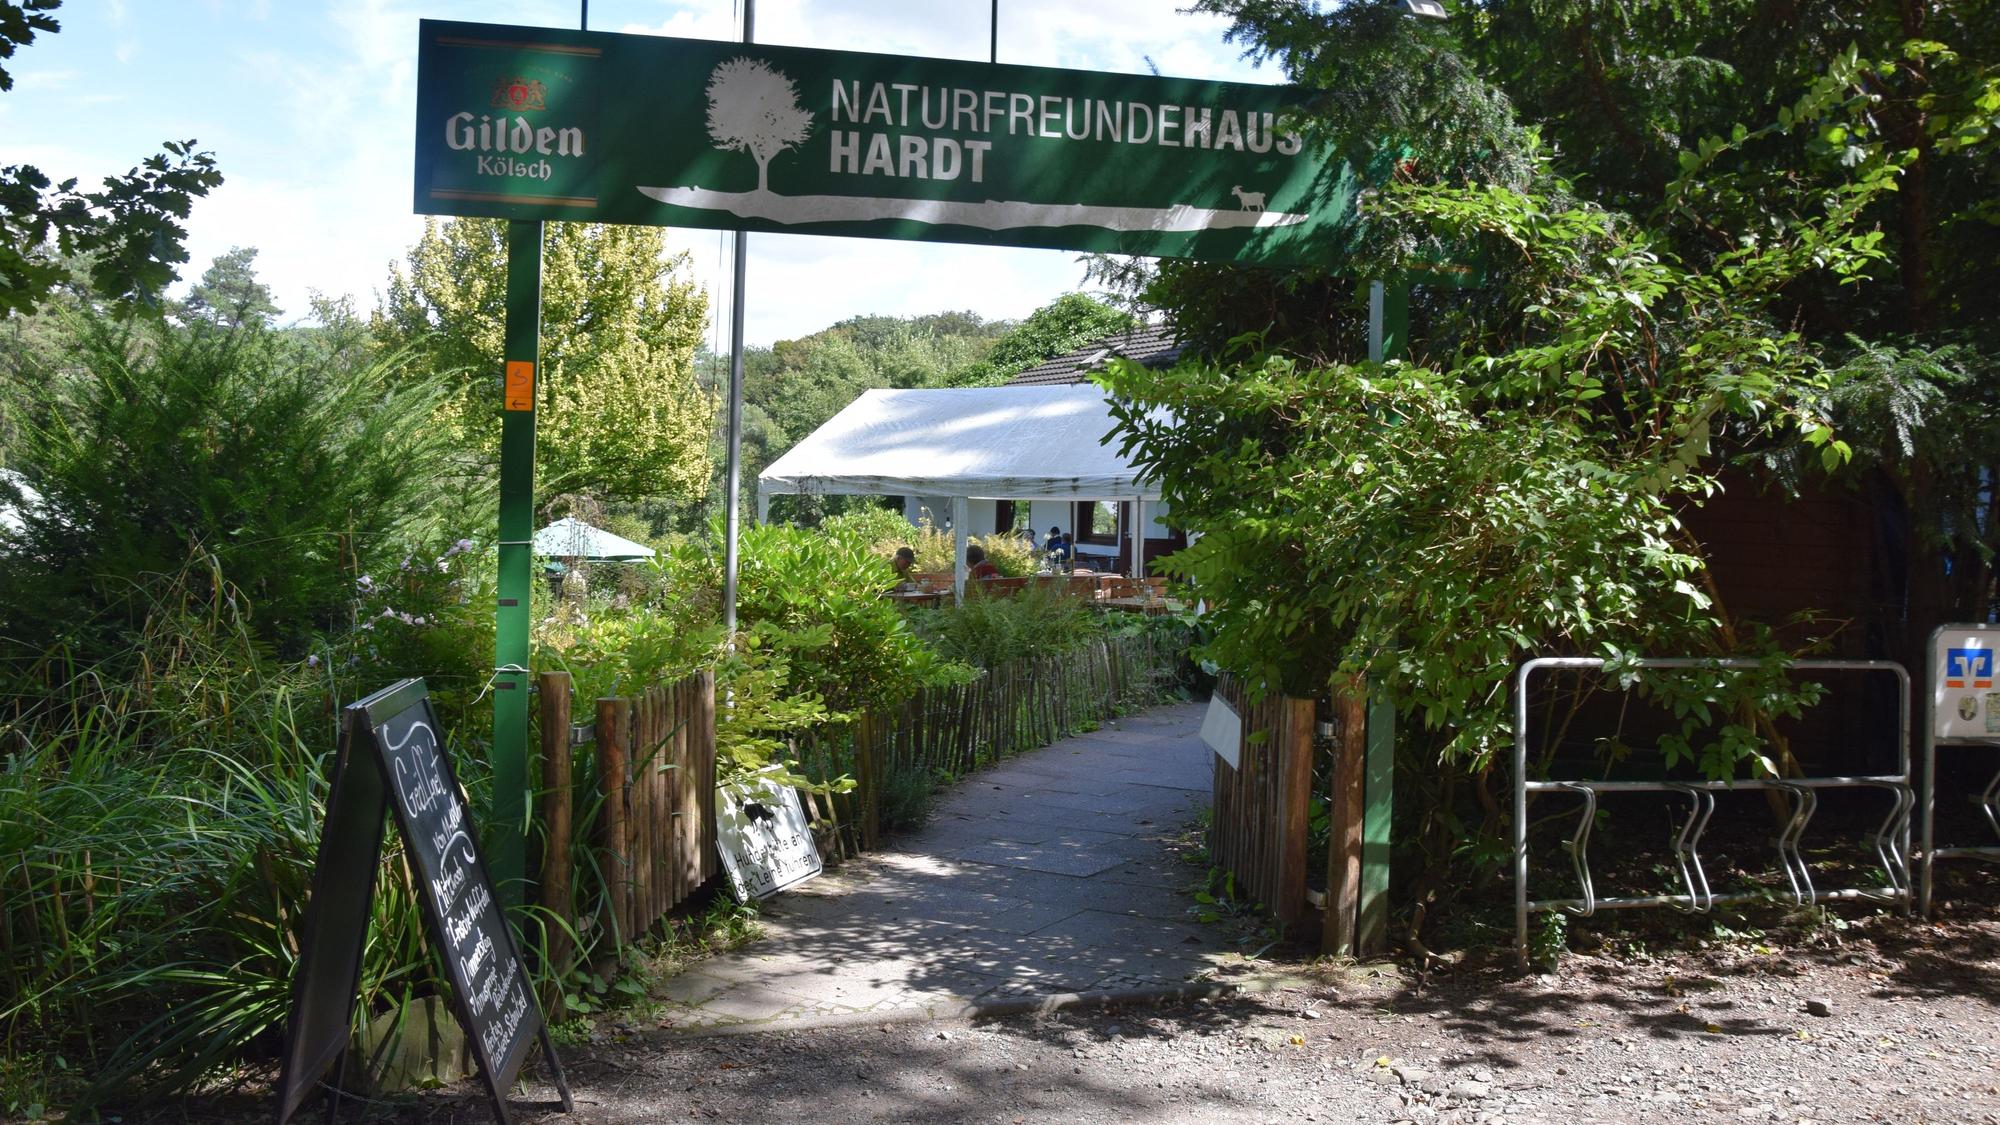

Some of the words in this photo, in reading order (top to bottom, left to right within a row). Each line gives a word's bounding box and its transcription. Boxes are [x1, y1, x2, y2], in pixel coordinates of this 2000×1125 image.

[445, 111, 585, 158] Gilden
[831, 78, 1303, 156] NATURFREUNDEHAUS
[477, 155, 552, 182] Kölsch
[829, 129, 992, 183] HARDT
[394, 738, 447, 818] Geöffnet
[791, 834, 802, 847] an
[432, 855, 465, 918] Mittwoch
[757, 865, 784, 886] Leine
[460, 926, 497, 988] Donnerstag
[504, 982, 528, 1038] Schnitzel
[483, 1020, 504, 1055] Freitag
